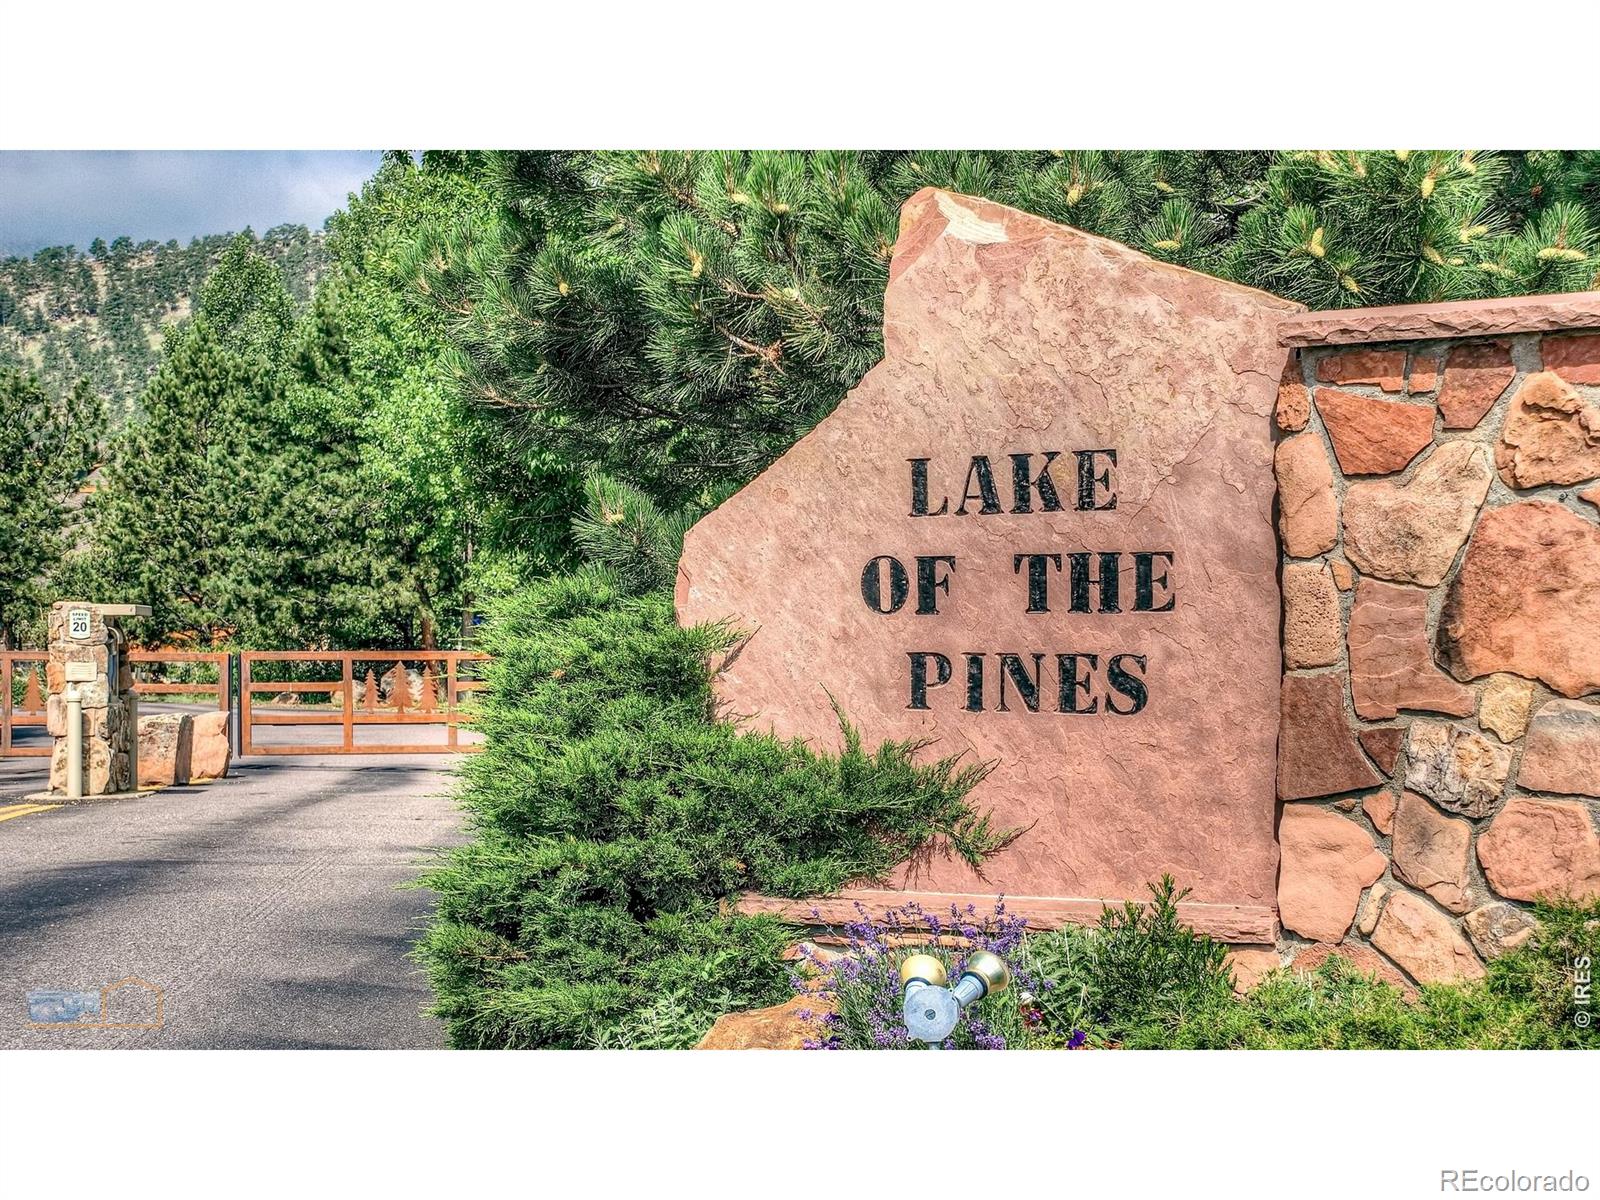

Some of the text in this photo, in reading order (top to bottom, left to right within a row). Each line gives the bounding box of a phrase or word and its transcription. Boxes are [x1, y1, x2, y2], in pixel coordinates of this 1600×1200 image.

[905, 449, 1118, 517] LAKE
[861, 551, 1175, 615] OF THE
[73, 622, 87, 632] 20
[905, 652, 1149, 715] PINES
